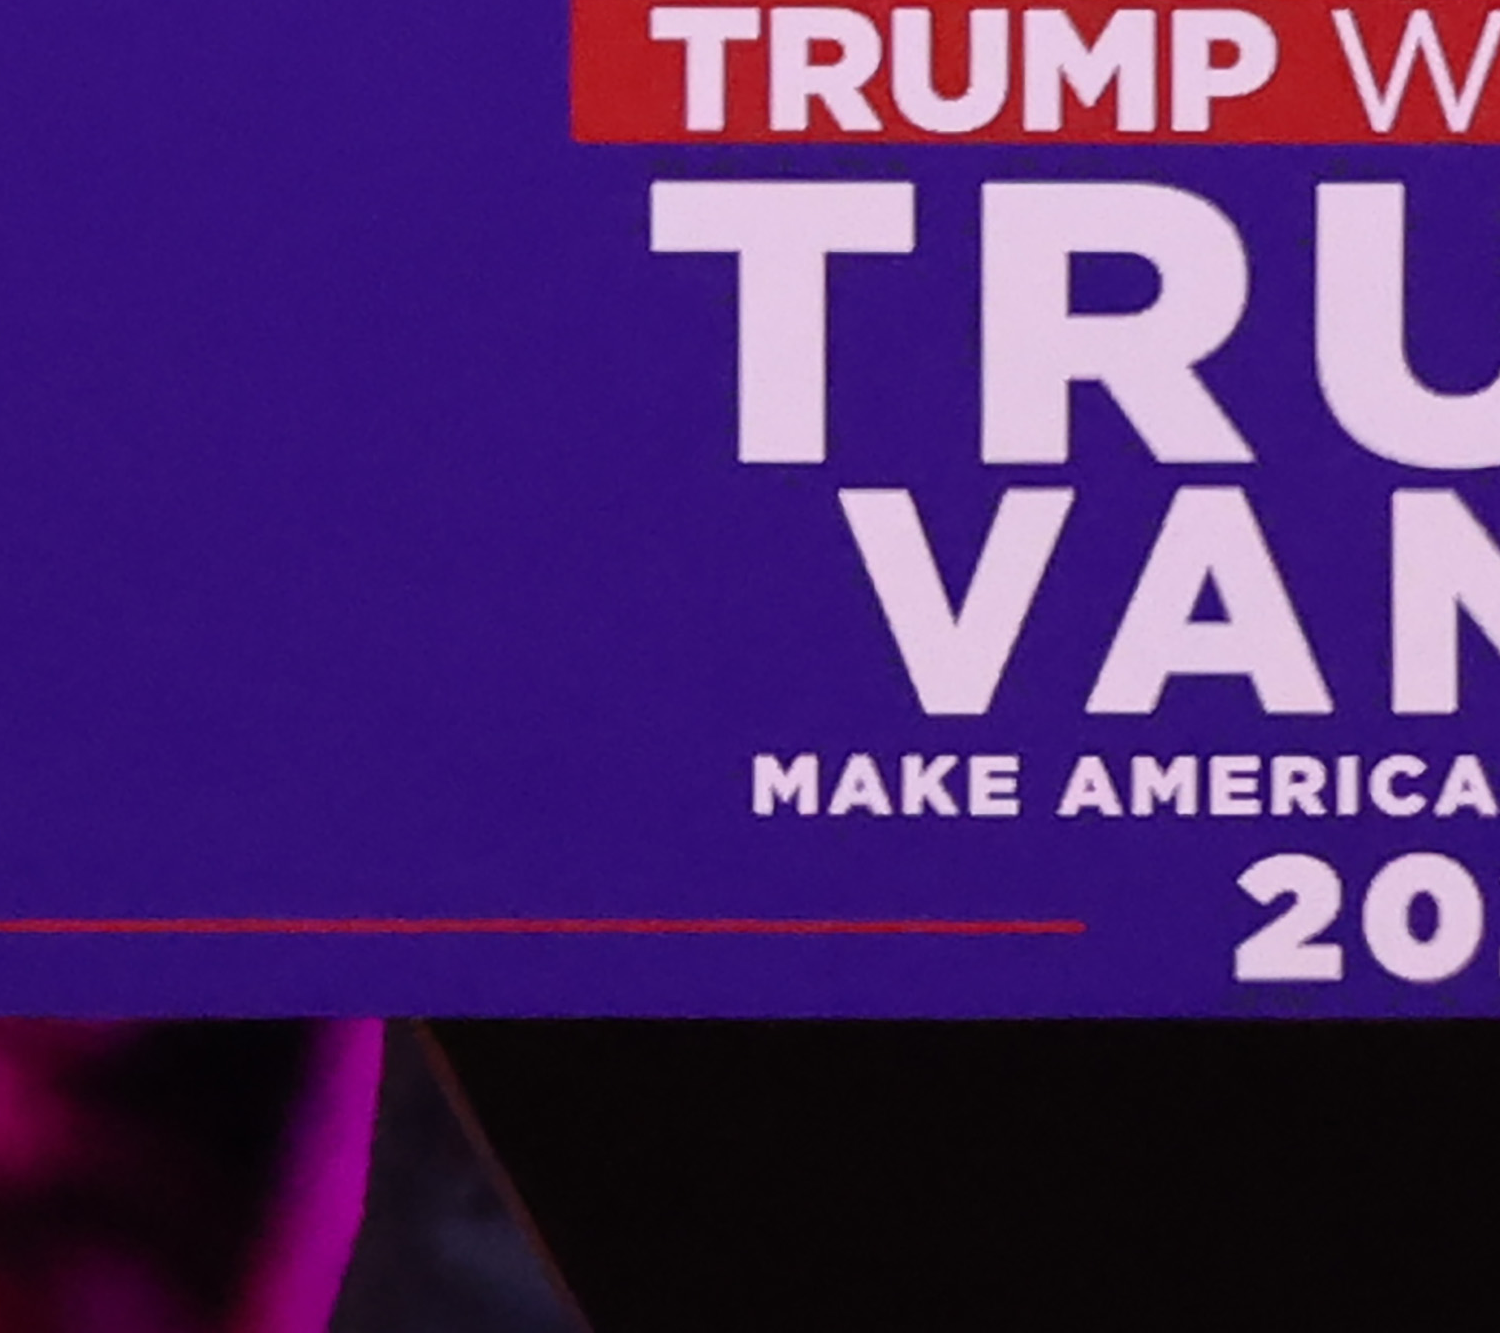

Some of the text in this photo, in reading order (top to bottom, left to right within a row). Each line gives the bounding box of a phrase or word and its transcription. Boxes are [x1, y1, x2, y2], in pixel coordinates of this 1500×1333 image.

[650, 7, 1277, 133] TRUMP
[753, 754, 1019, 815] MAKE
[1057, 755, 1498, 816] AMERICA
